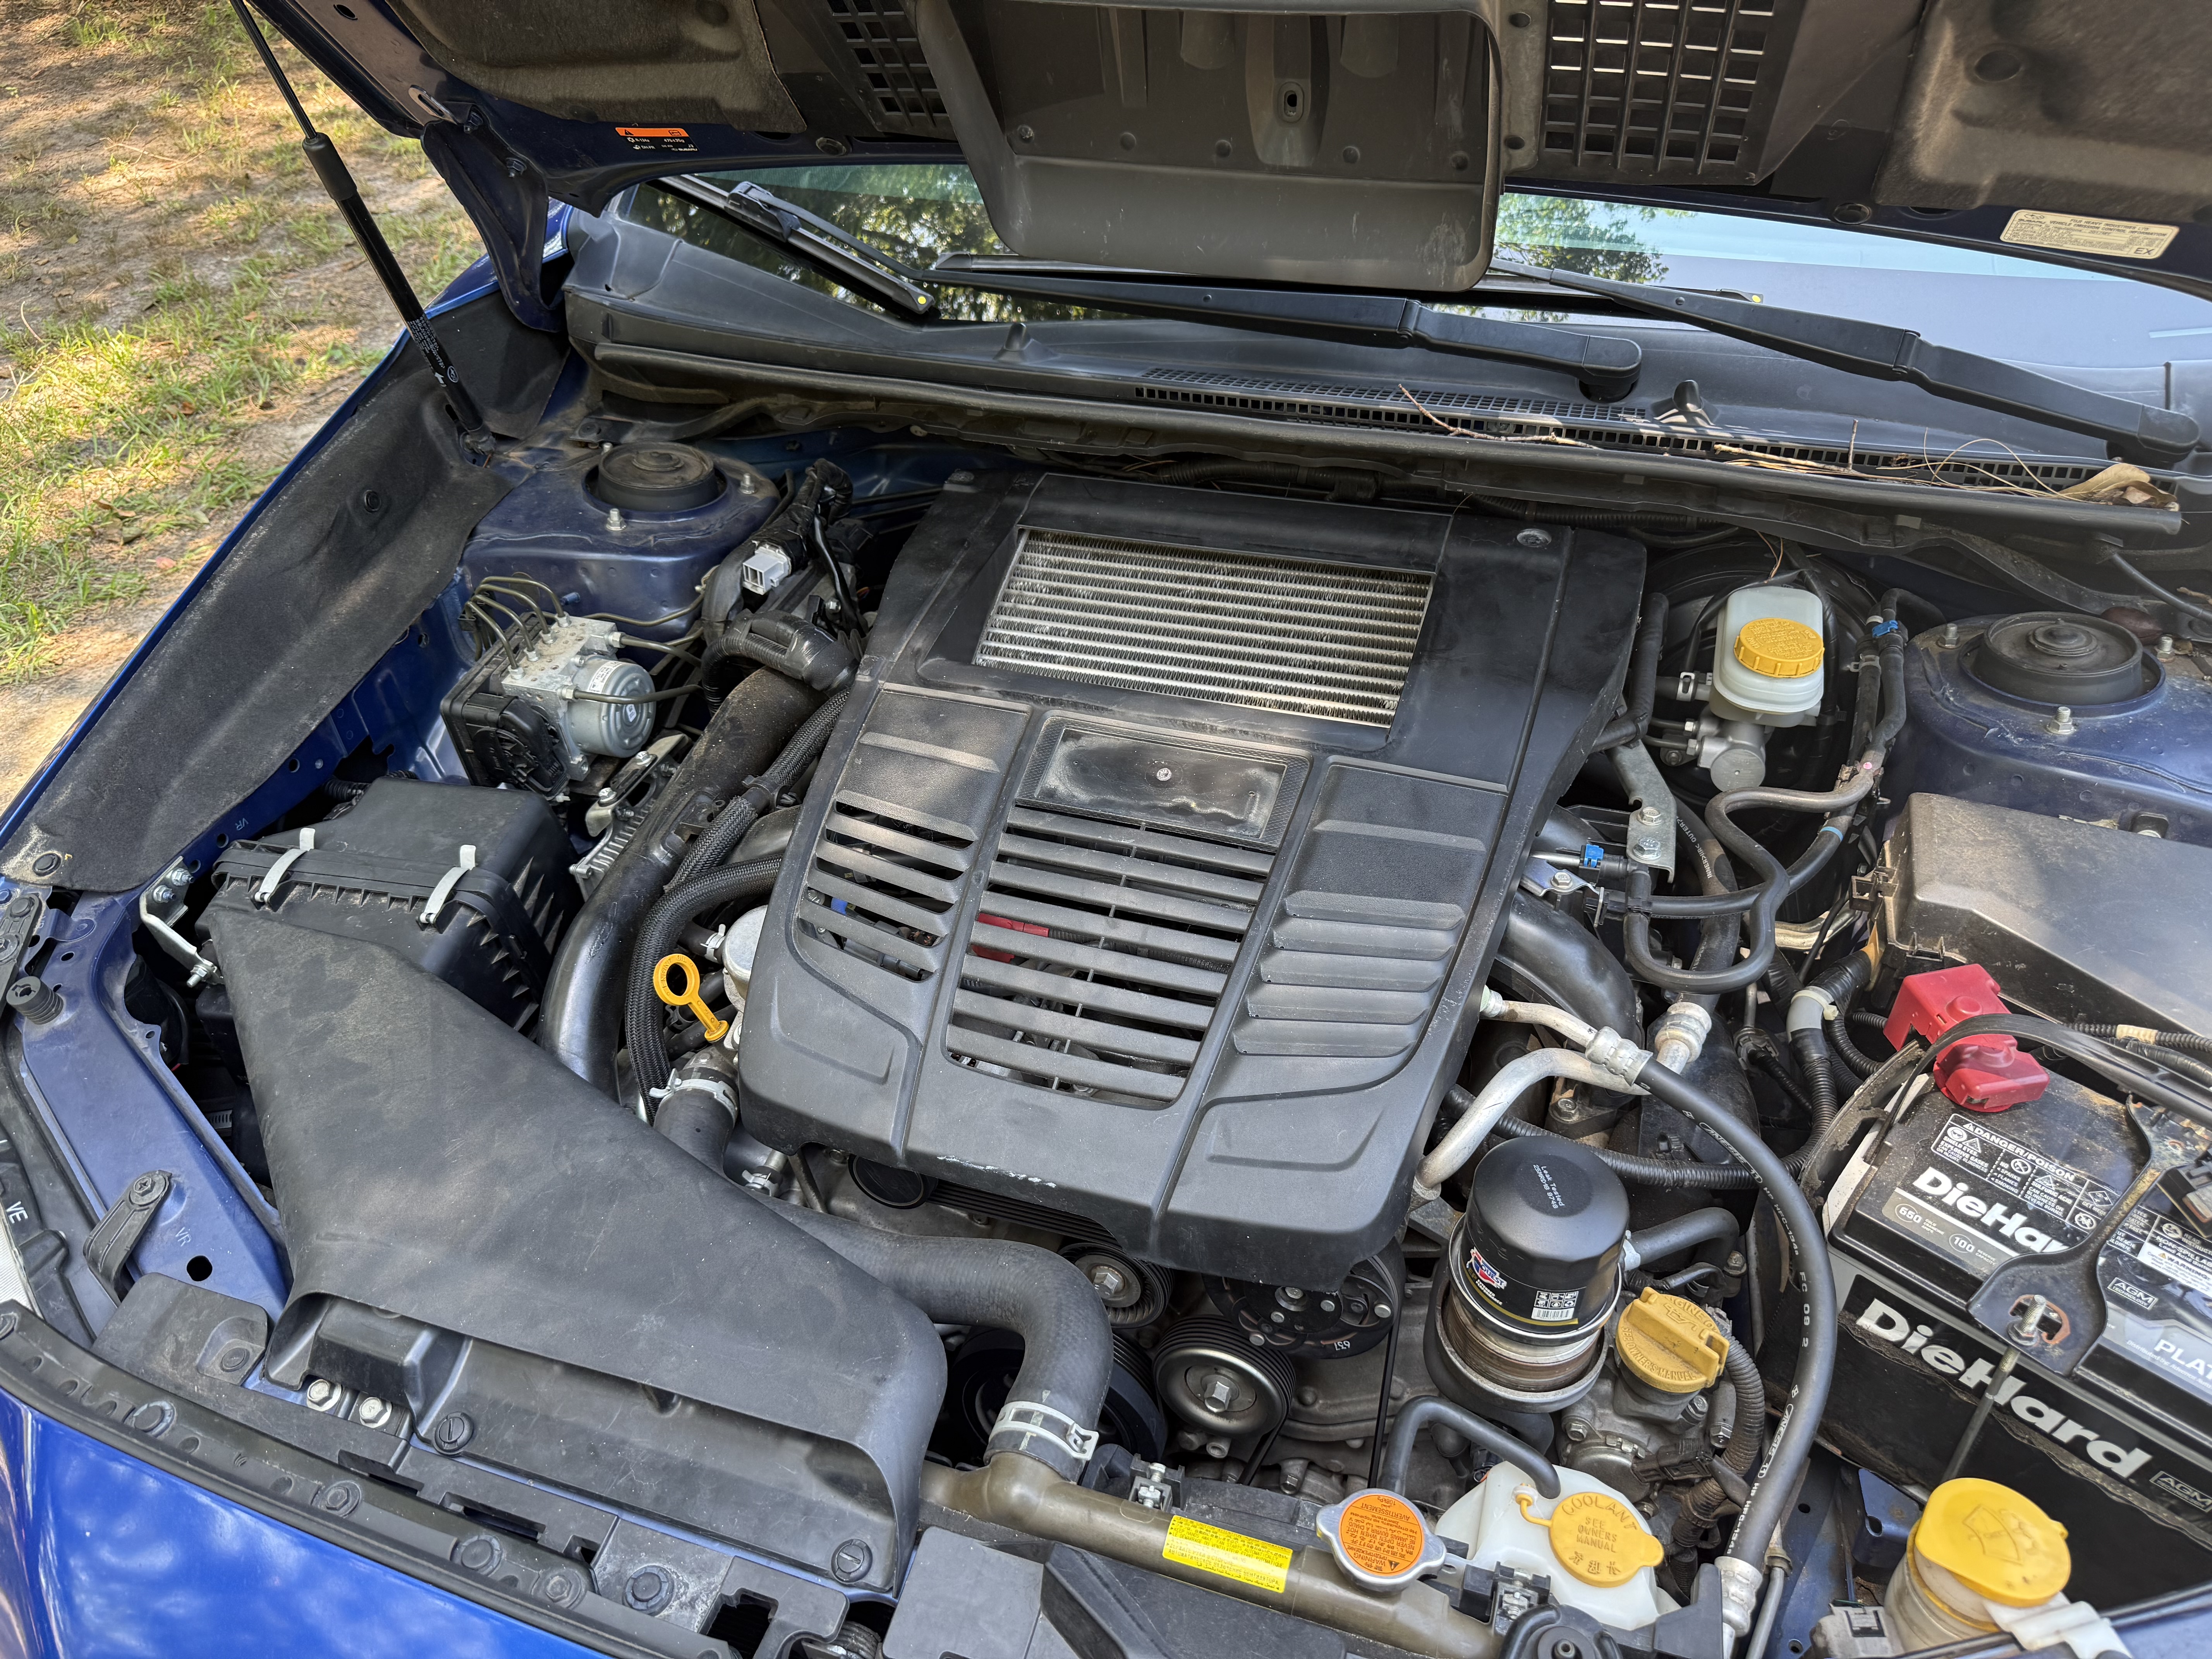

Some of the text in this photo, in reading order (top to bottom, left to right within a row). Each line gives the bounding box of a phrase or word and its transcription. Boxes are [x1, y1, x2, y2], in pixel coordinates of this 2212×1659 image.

[2134, 247, 2155, 256] EX
[235, 817, 249, 831] VR
[1943, 1136, 1962, 1148] SHIELD
[1940, 1140, 1989, 1168] EXPLOSIVE GASES
[1948, 1149, 1962, 1159] CAUSE
[1963, 1157, 1988, 1173] BLINDNESS
[1974, 1127, 2075, 1181] DANGER/POISON
[1998, 1174, 2019, 1187] FLAMES
[2001, 1169, 2021, 1182] SPARKS
[1541, 1165, 1565, 1207] Leak Tested
[1995, 1179, 2019, 1193] SMOKING
[2032, 1181, 2073, 1204] SULFURIC ACID
[1546, 1191, 1558, 1209] 8748
[2024, 1194, 2044, 1207] SEVERE
[2027, 1190, 2056, 1208] BLINDNESS
[2040, 1192, 2057, 1203] CAUSE
[5, 1200, 28, 1224] VE
[1899, 1206, 1922, 1224] 650
[2133, 1209, 2147, 1218] EYES
[1923, 1222, 1944, 1235] CRANKING
[175, 1226, 192, 1247] VR
[2116, 1236, 2136, 1249] REACH
[2184, 1233, 2200, 1245] READ
[1954, 1237, 1975, 1253] 100
[2156, 1236, 2212, 1267] NON-SPILLAB
[1975, 1252, 1996, 1266] CAPACITY
[2159, 1243, 2176, 1254] Lead
[2176, 1252, 2192, 1262] Acid
[2112, 1286, 2148, 1307] TECHNOLOGY
[2114, 1282, 2154, 1303] AGM
[1802, 1336, 1809, 1347] 2
[1622, 1326, 1696, 1381] SEE OWNER'S MANUAL
[1855, 1298, 2153, 1480] DieHard
[1377, 1496, 1396, 1505] 108kPa
[1360, 1503, 1410, 1521] AVERTISSEMENT
[1562, 1497, 1637, 1532] COOLANT
[1585, 1516, 1607, 1527] SEE
[1360, 1530, 1377, 1539] WHEN
[1371, 1528, 1388, 1537] OUVRIR
[1390, 1533, 1408, 1543] JAMAIS
[1577, 1525, 1618, 1543] OWNERS
[1226, 1543, 1242, 1551] STARTS
[1379, 1535, 1394, 1545] OPEN
[1396, 1540, 1414, 1549] NEVER
[1576, 1534, 1617, 1554] MANUAL
[1211, 1543, 1239, 1554] VENTILATEUR
[1353, 1552, 1385, 1566] WARNING
